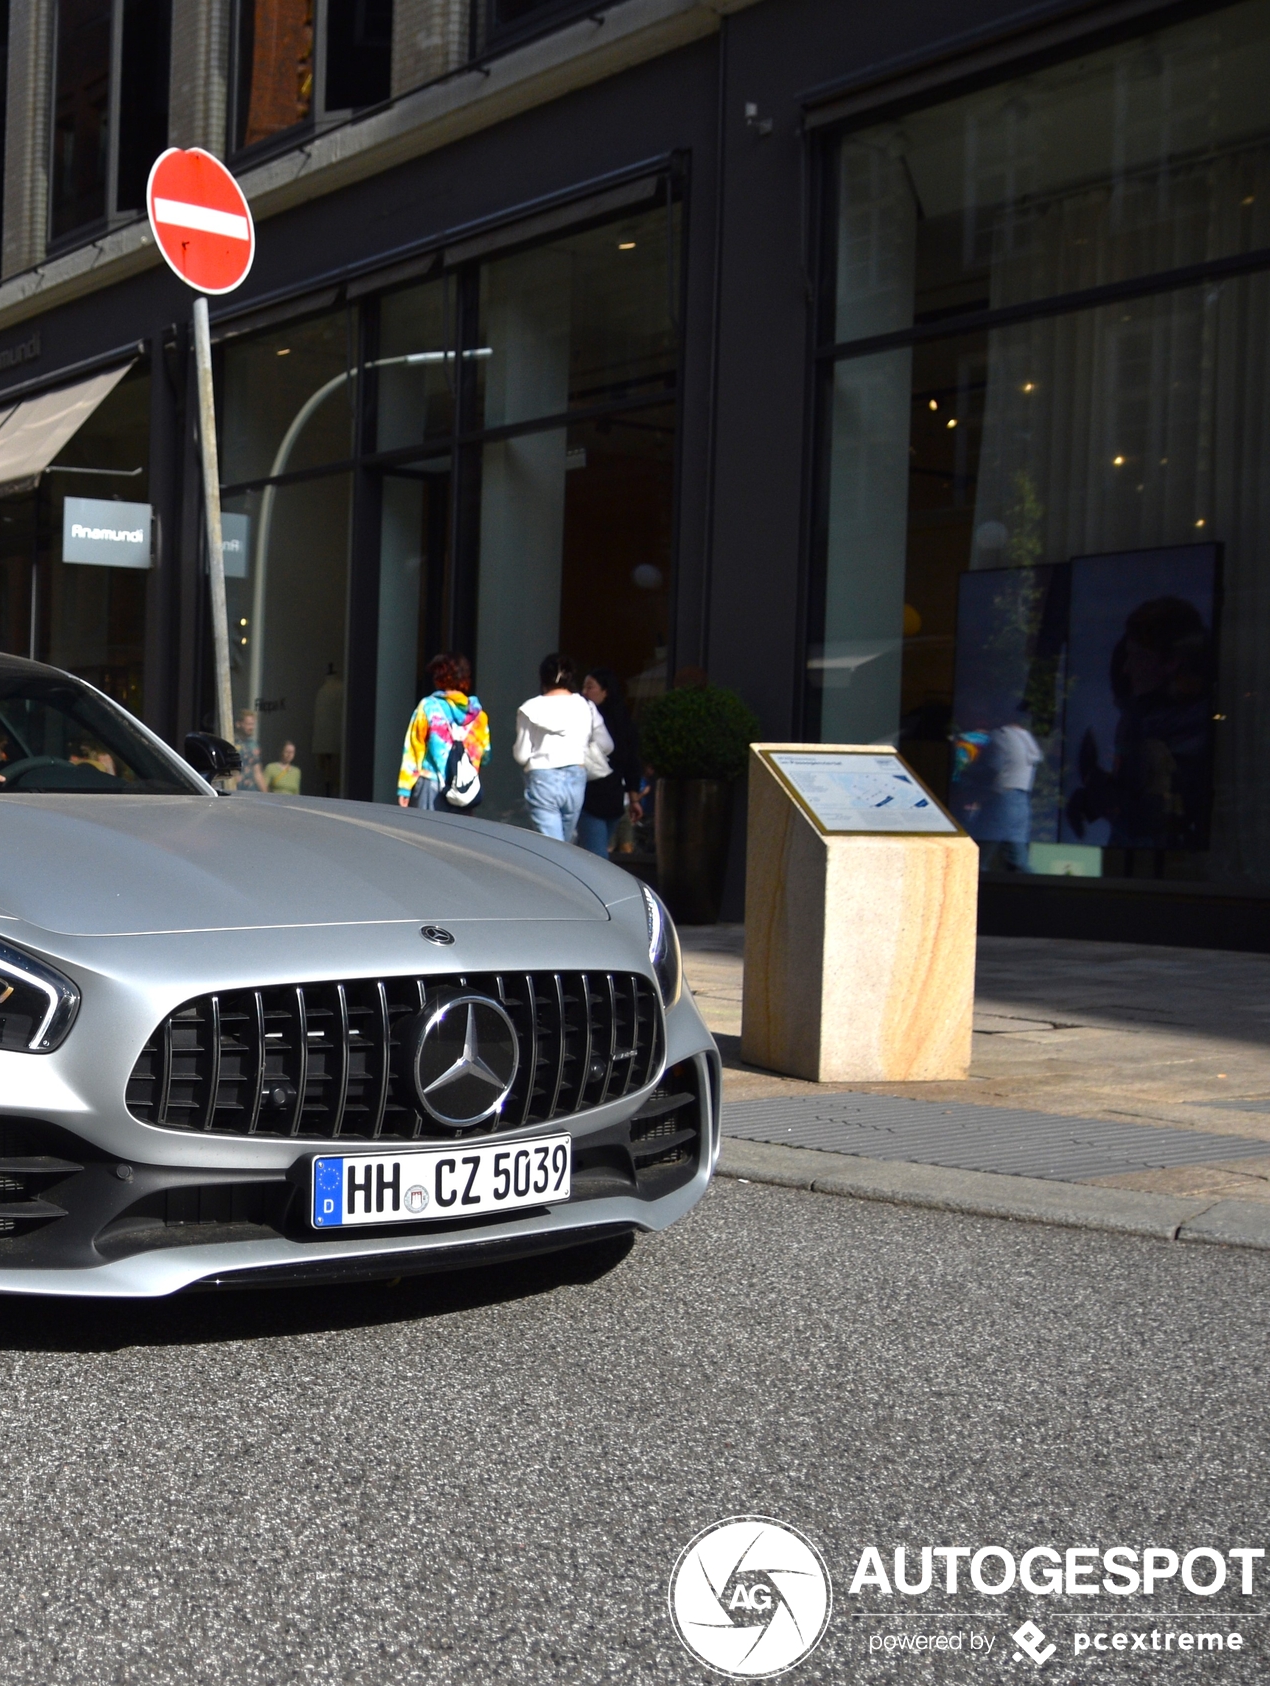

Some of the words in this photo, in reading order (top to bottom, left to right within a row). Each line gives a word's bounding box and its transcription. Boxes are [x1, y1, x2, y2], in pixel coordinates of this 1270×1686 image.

[71, 523, 144, 544] Anamundi
[347, 1162, 400, 1215] HH
[434, 1155, 481, 1207] CZ
[493, 1144, 568, 1200] 5039
[323, 1198, 334, 1214] D
